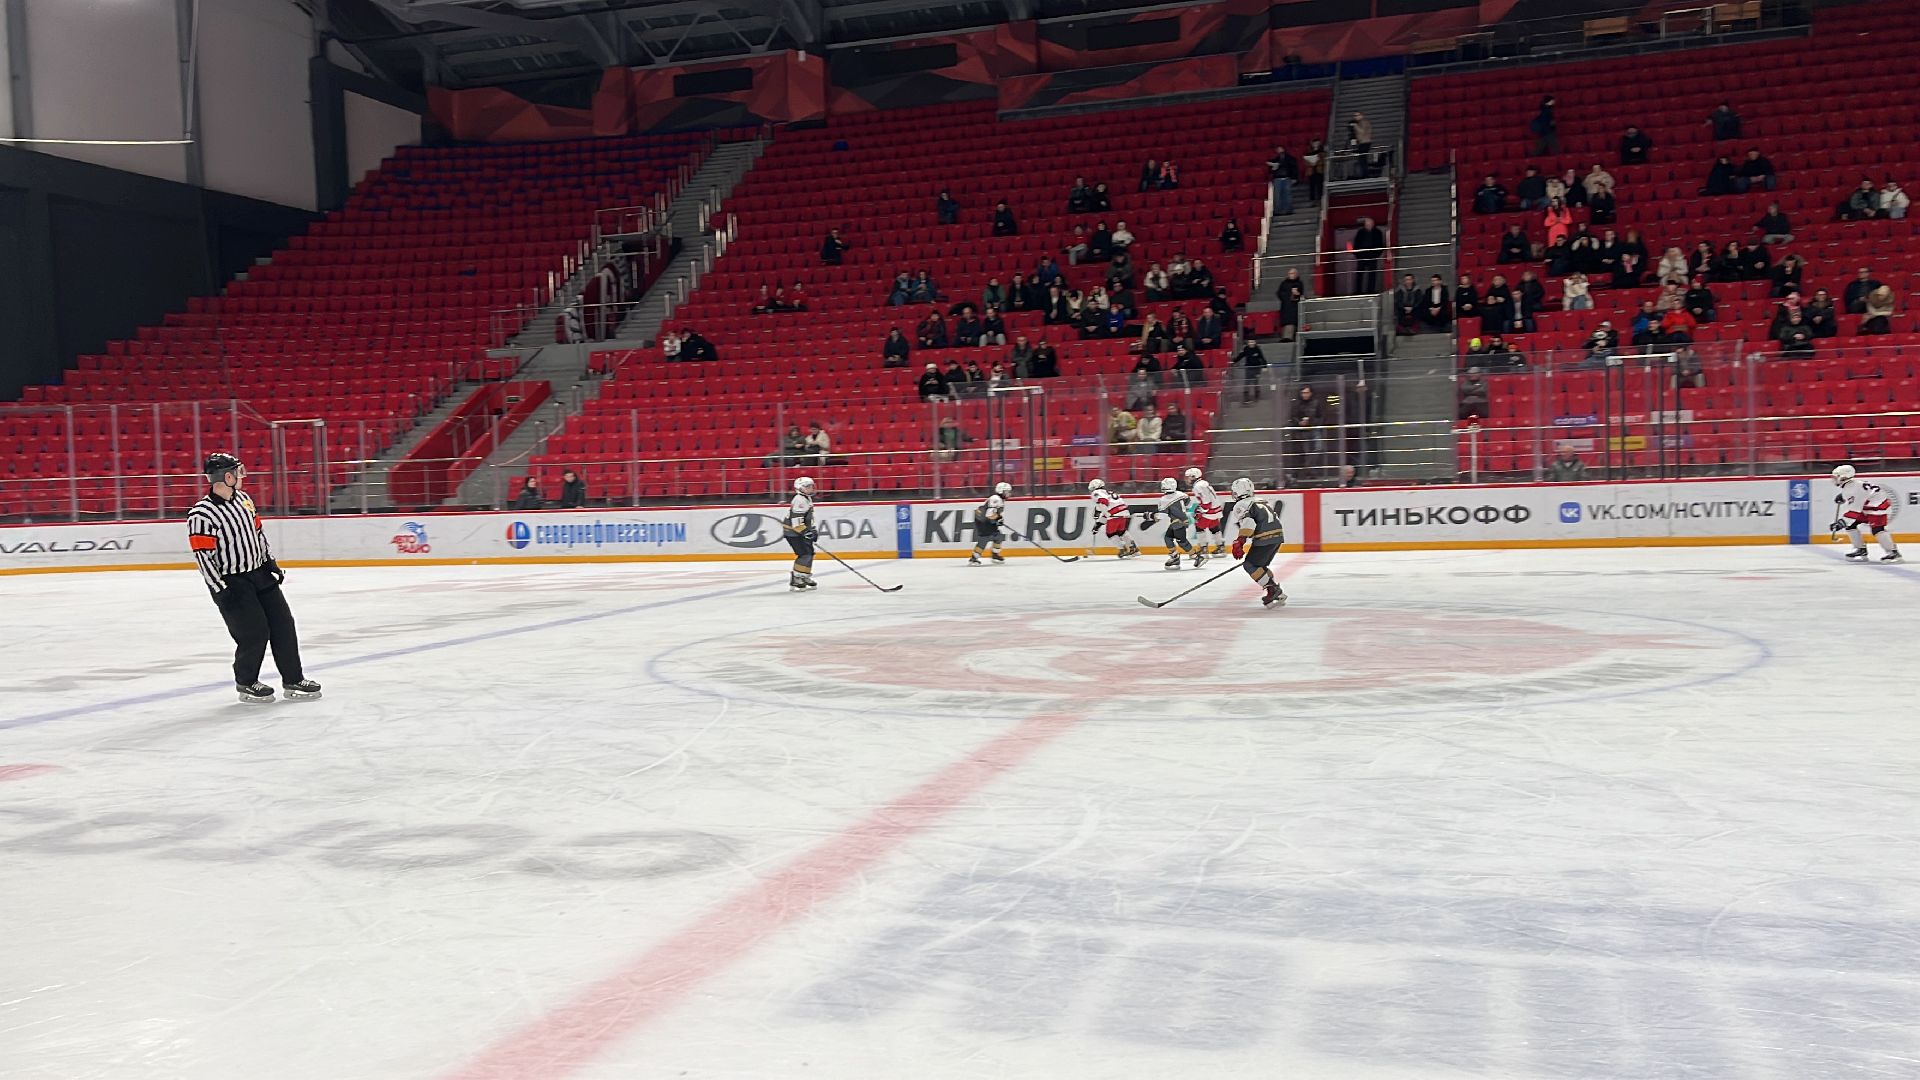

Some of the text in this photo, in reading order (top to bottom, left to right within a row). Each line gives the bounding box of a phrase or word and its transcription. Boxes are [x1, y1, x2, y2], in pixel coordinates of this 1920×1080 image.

[1334, 504, 1532, 527] ТИНЬКОФФ
[1587, 500, 1775, 520] VK.COM/HCVITYAZ
[817, 518, 877, 541] ADA
[924, 506, 1086, 544] KH.RU
[0, 539, 133, 554] VALDAI
